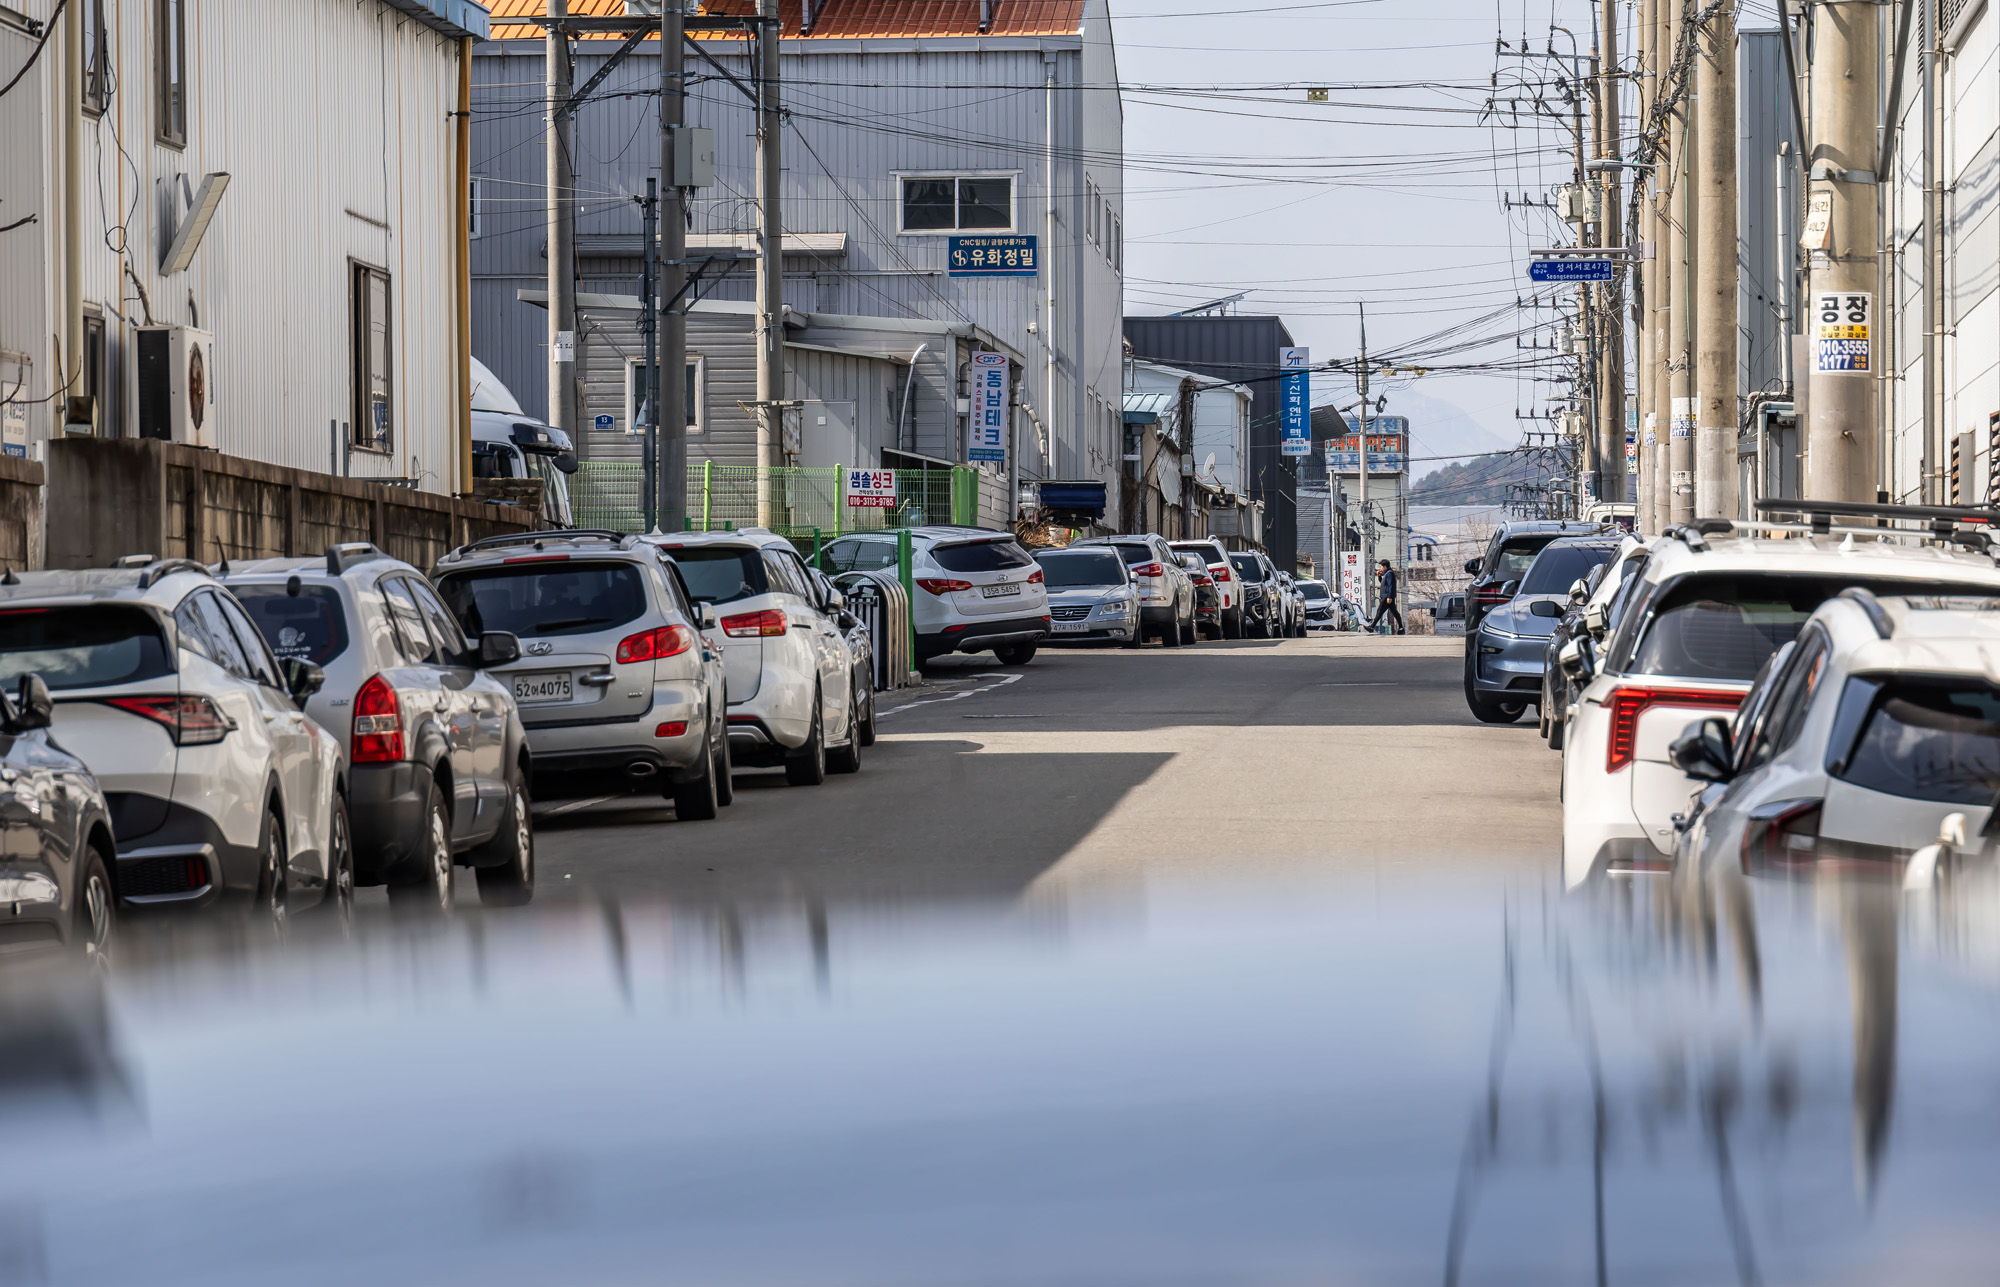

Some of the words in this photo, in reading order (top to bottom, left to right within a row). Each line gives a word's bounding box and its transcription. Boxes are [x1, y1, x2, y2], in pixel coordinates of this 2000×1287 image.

[970, 248, 1034, 267] 유화정밀
[1557, 262, 1610, 273] 성서서로47길
[1820, 296, 1868, 323] 공장
[1819, 340, 1868, 355] 010-3555
[984, 370, 1002, 445] 동남테크
[850, 471, 893, 489] 샘솔싱크
[850, 496, 894, 506] 010-3113-9785
[516, 680, 571, 698] 52어4075
